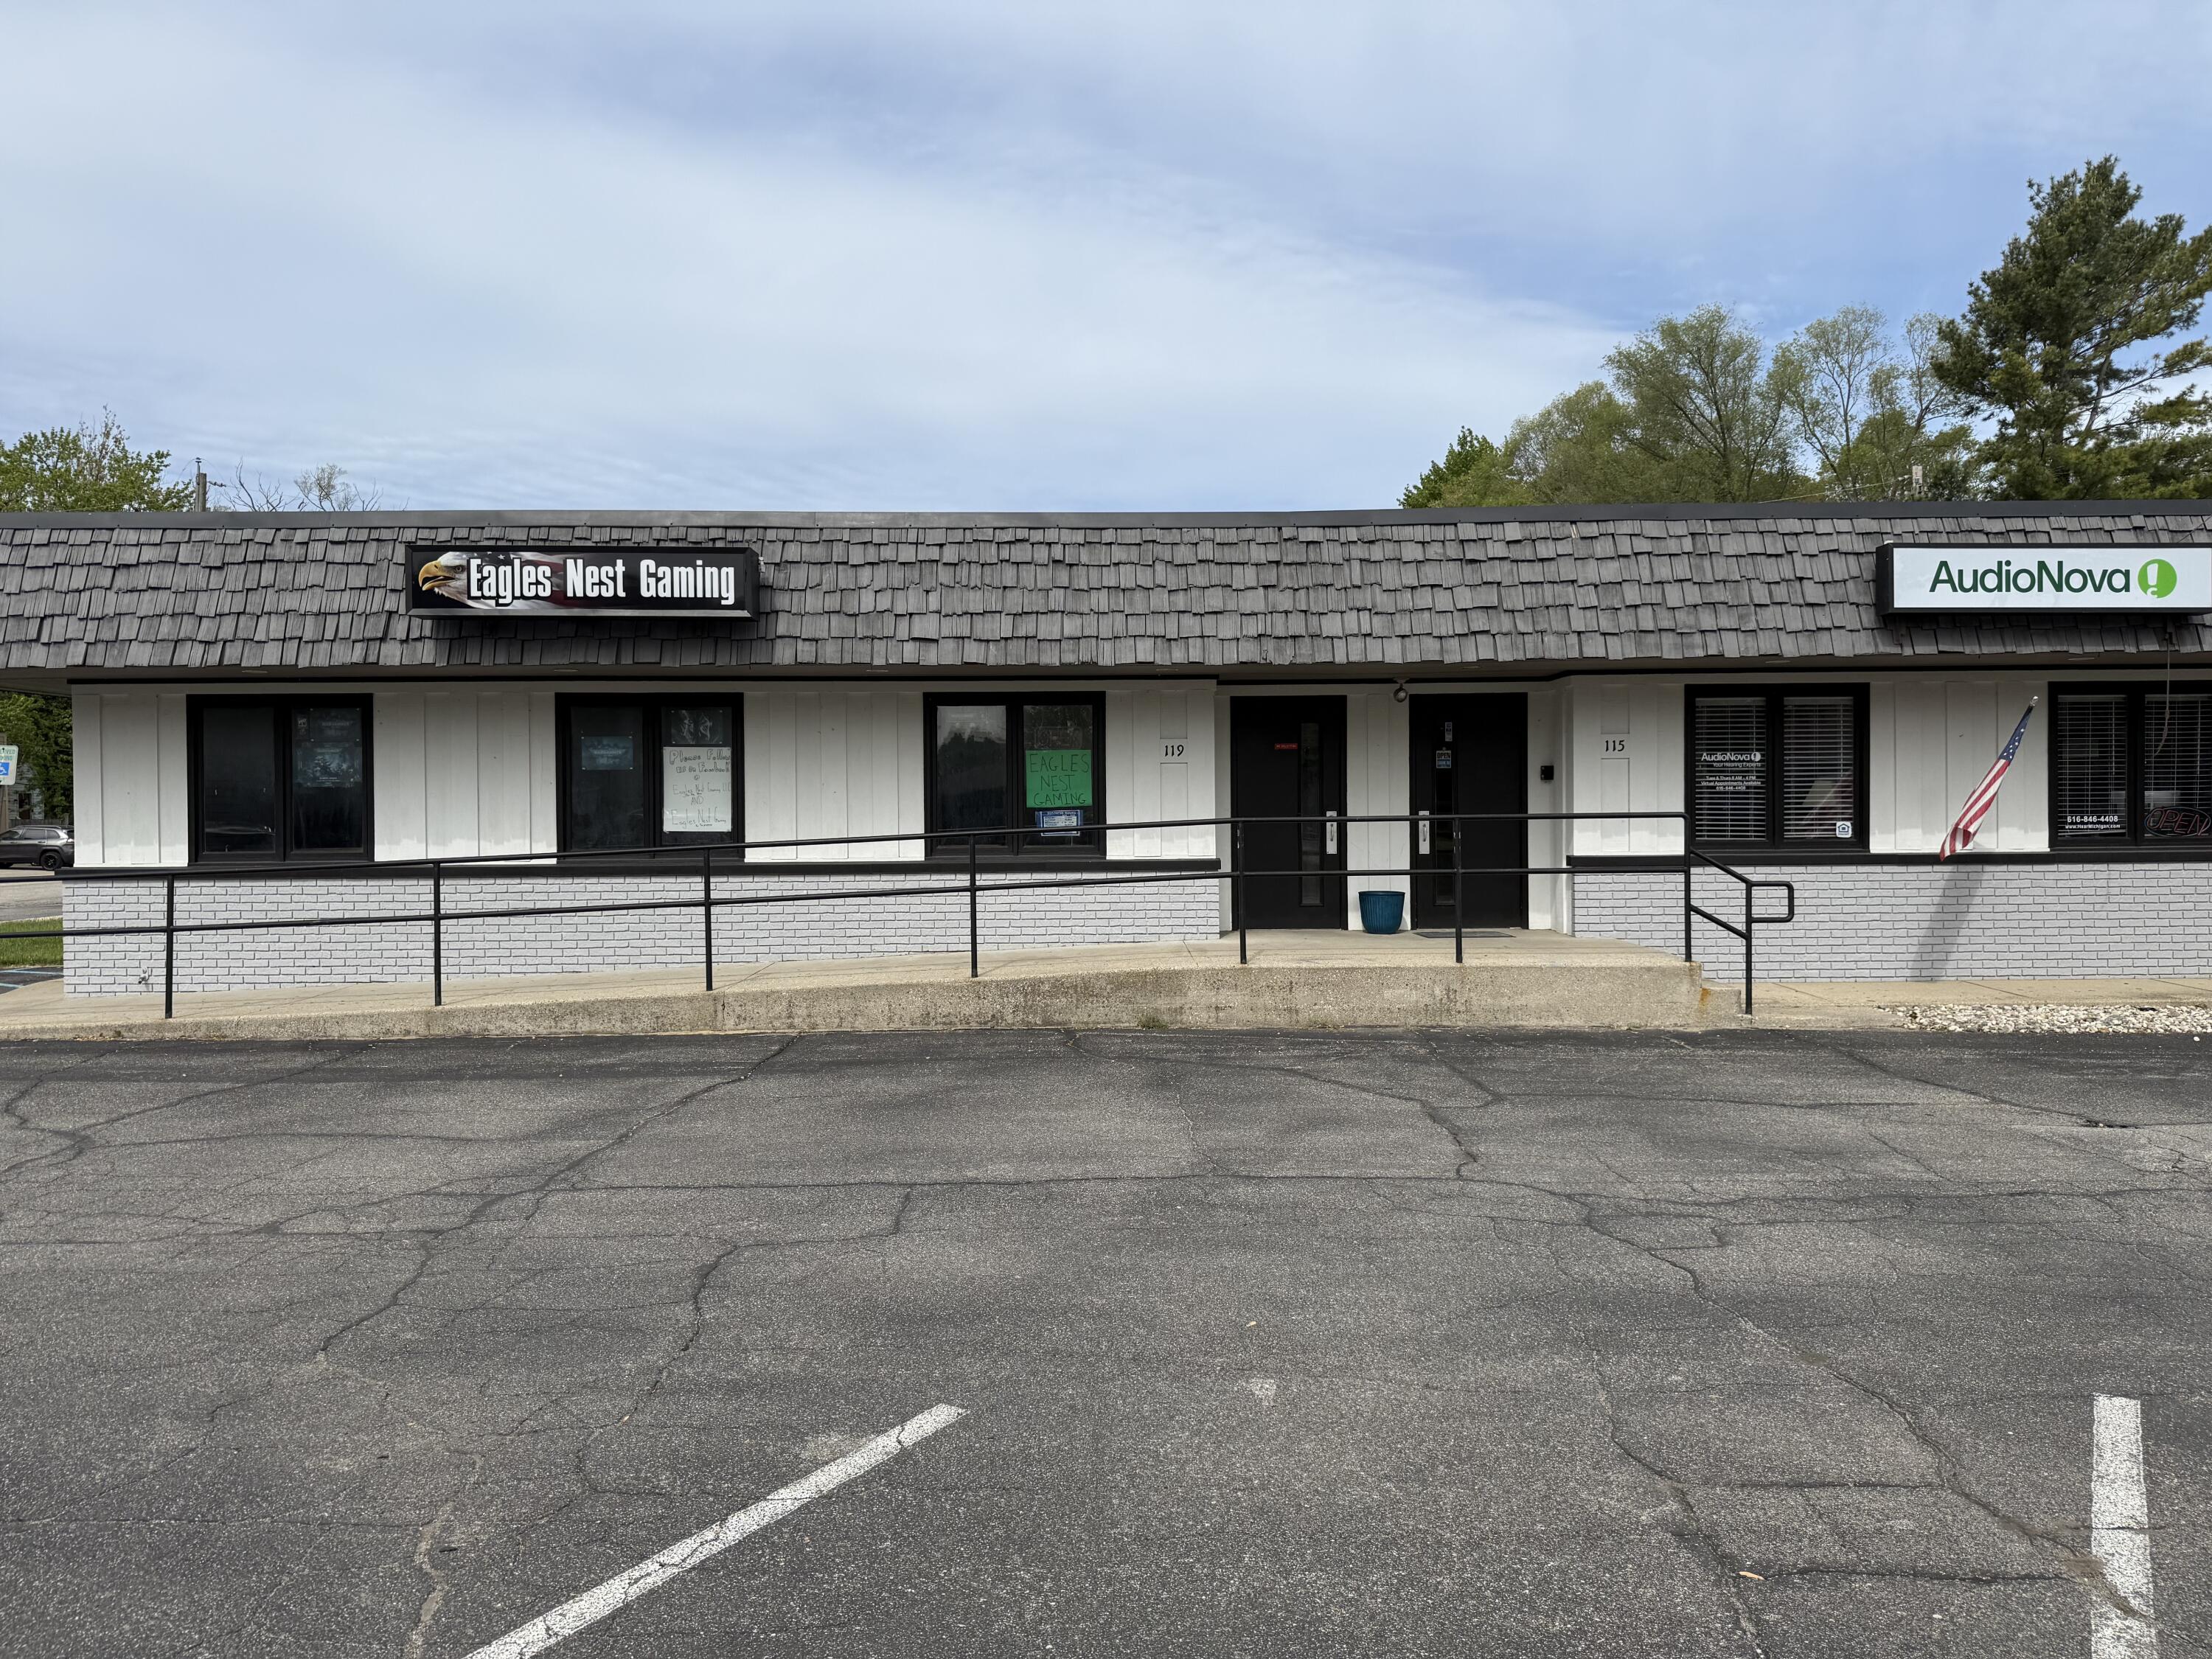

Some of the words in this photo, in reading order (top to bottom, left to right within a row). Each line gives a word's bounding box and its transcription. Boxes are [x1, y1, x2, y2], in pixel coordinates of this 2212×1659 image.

[470, 559, 552, 604] Eagles
[566, 559, 625, 597] Nest
[640, 559, 735, 605] Gaming
[1929, 560, 2130, 593] AudioNova
[1165, 745, 1184, 757] 119
[1605, 740, 1625, 752] 115
[1030, 754, 1090, 773] EAGLES
[1701, 752, 1750, 761] AudioNova
[1041, 774, 1075, 791] NEST
[691, 796, 703, 805] AND
[1034, 793, 1086, 806] GAMING
[672, 808, 695, 829] Eagles
[698, 808, 711, 823] Nest
[2146, 808, 2208, 835] OPEN
